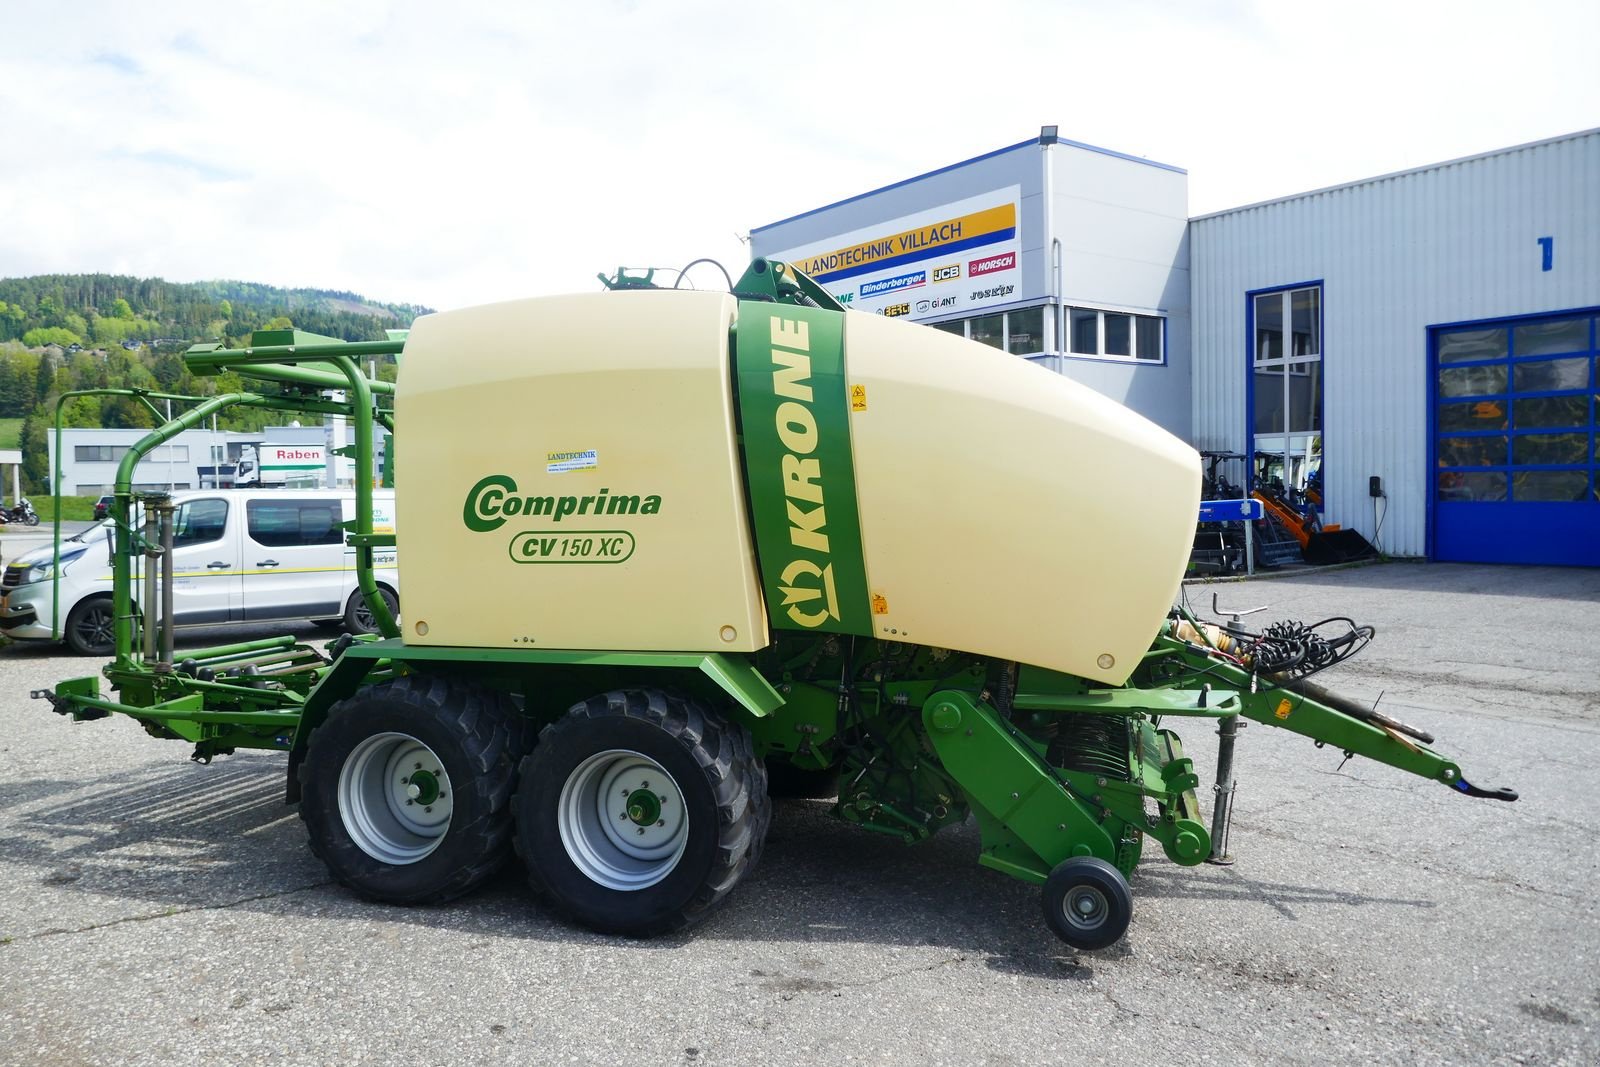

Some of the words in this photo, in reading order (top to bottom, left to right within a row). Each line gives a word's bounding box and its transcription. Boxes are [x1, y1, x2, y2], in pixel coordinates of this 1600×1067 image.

[805, 239, 894, 275] LANDTECHNIK
[899, 222, 962, 251] VILLACH
[1537, 236, 1553, 272] 1
[978, 256, 1013, 272] HORSCH
[934, 266, 960, 281] JCB
[861, 273, 925, 294] Binderberger
[970, 284, 1014, 301] JOSKIN
[770, 315, 830, 554] KRONE
[276, 450, 320, 459] Raben
[547, 451, 596, 461] LANDTECHNIK
[522, 538, 557, 557] CV
[561, 538, 593, 557] 150
[596, 537, 624, 557] XC
